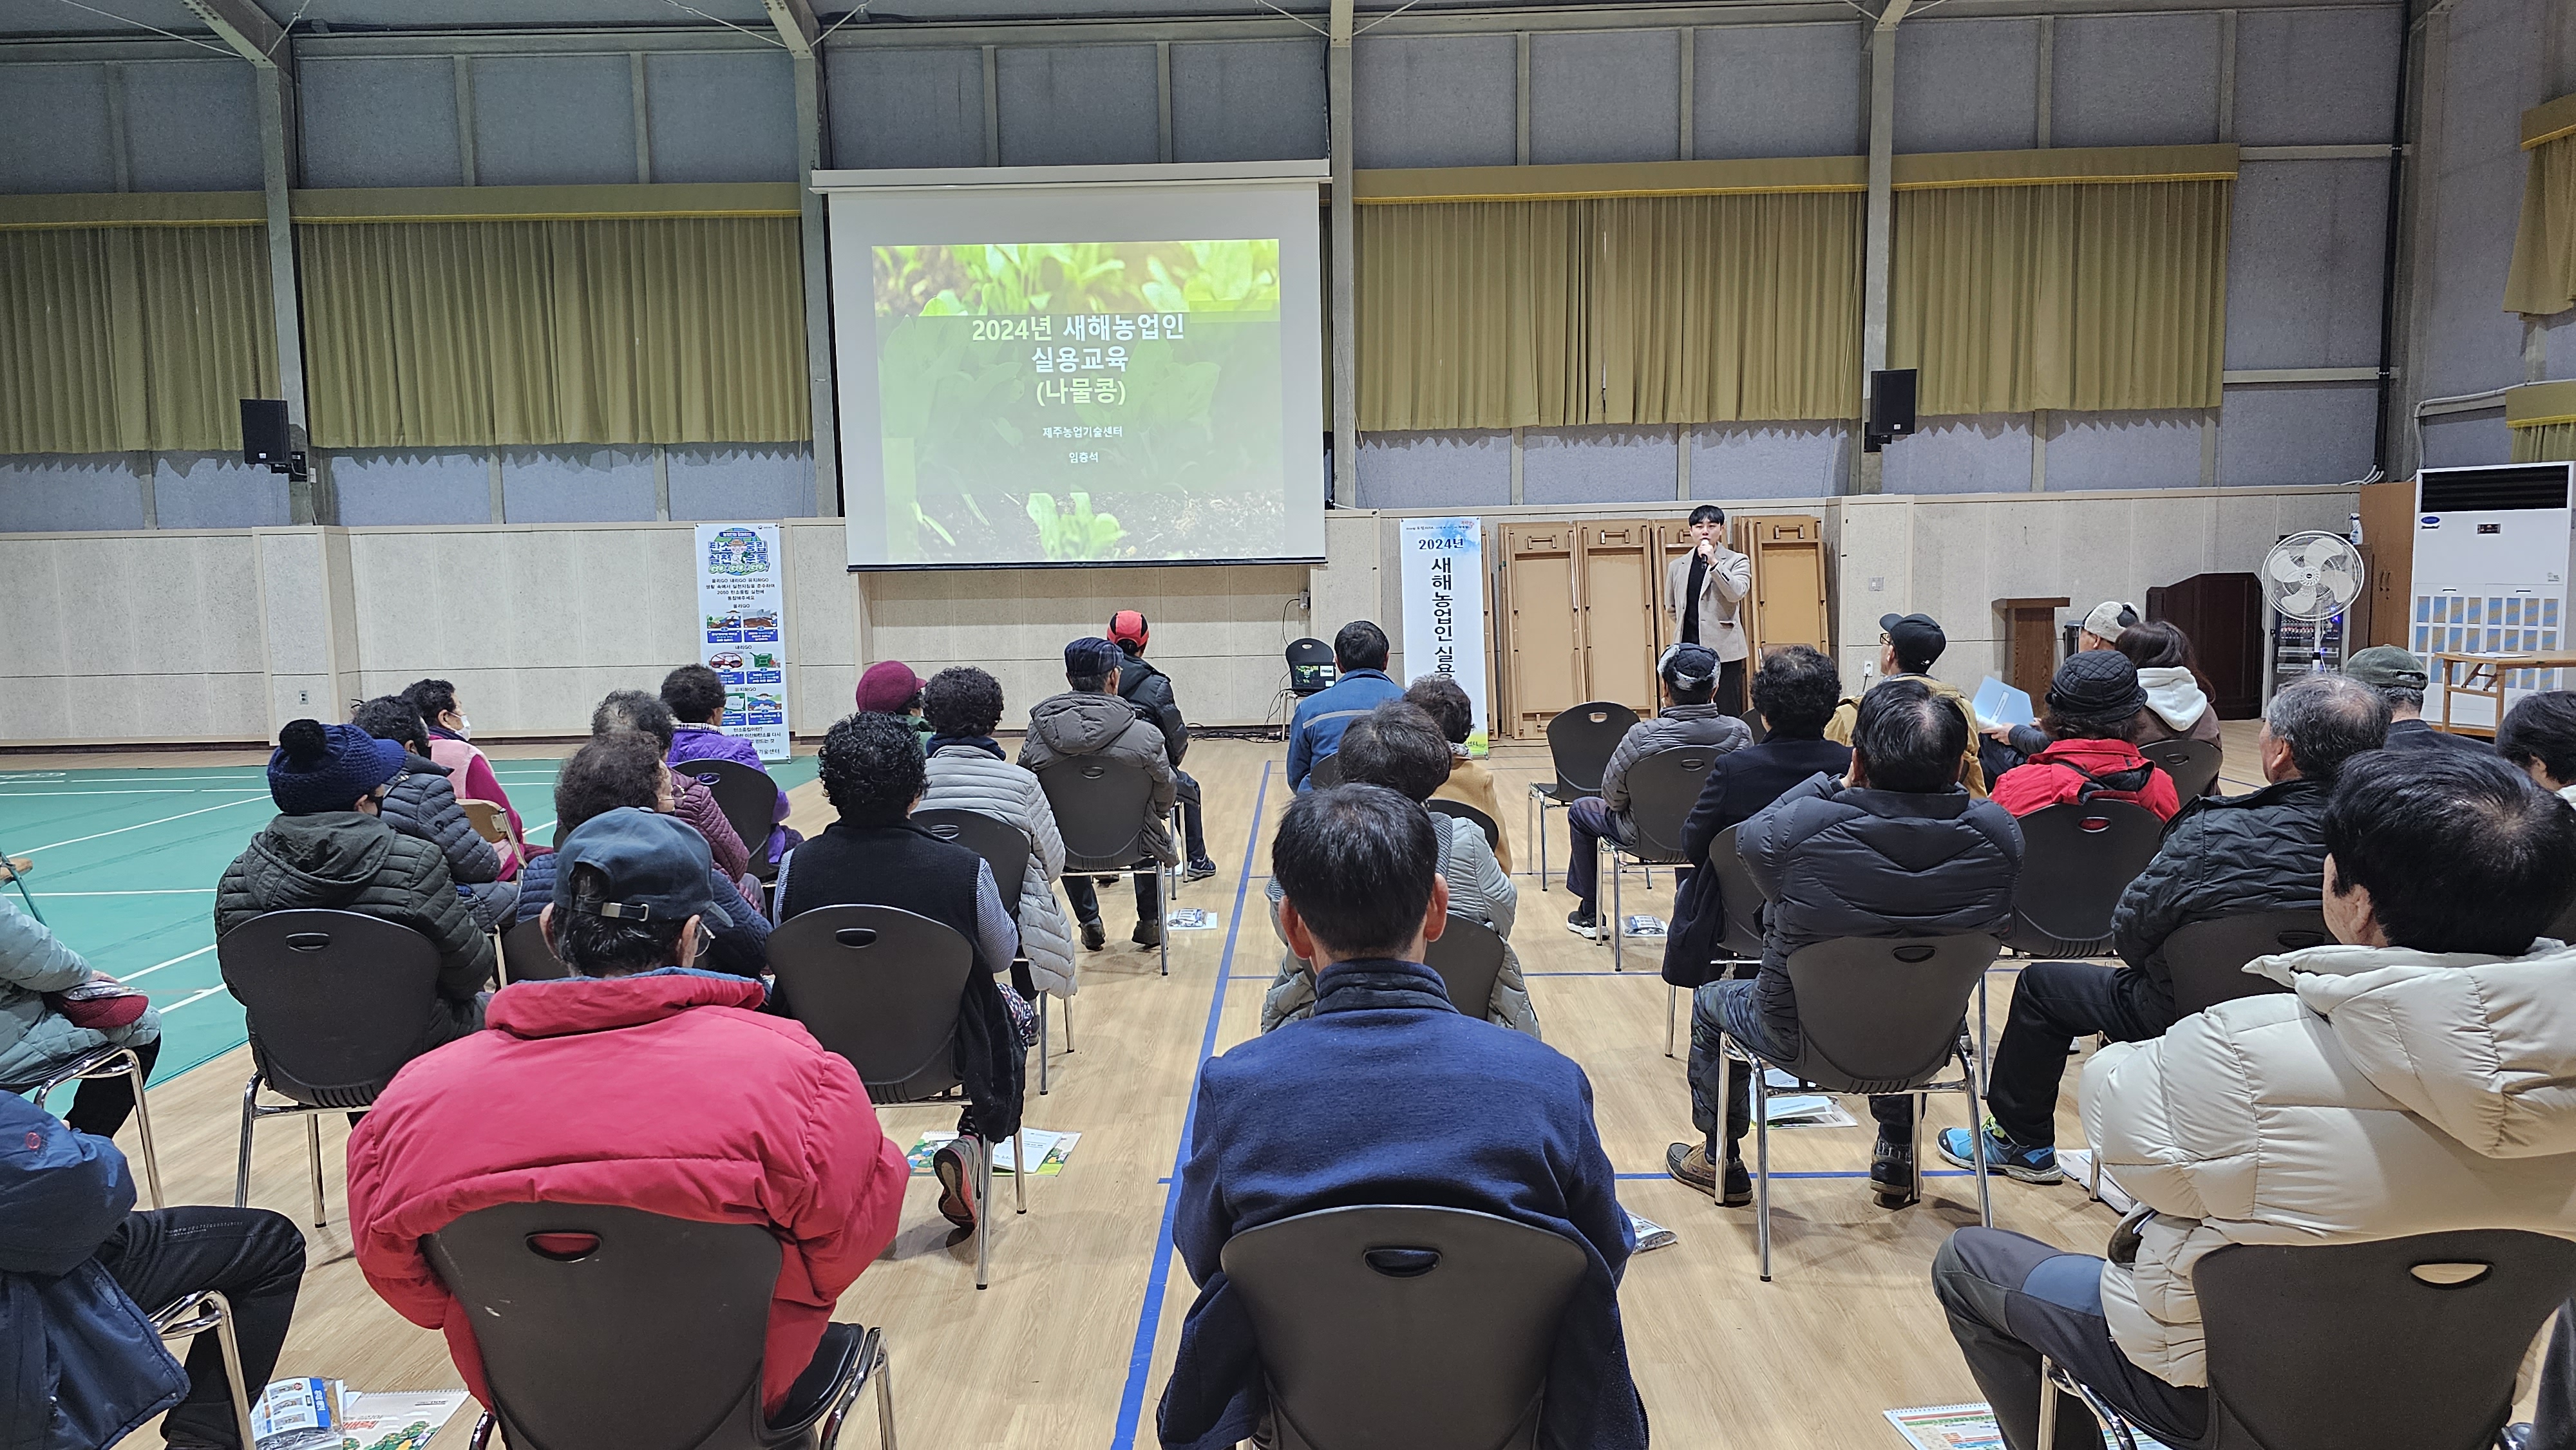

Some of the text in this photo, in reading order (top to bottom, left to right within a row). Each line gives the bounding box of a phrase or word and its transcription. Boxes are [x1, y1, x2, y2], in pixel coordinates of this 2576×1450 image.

[972, 313, 1184, 342] 2024년 새해농업인
[1031, 346, 1129, 373] 실용교육
[1036, 377, 1126, 407] (나물콩)
[1043, 426, 1122, 438] 제주농업기술센터
[1419, 538, 1464, 550] 2024년
[1431, 557, 1454, 642] 새해농업인
